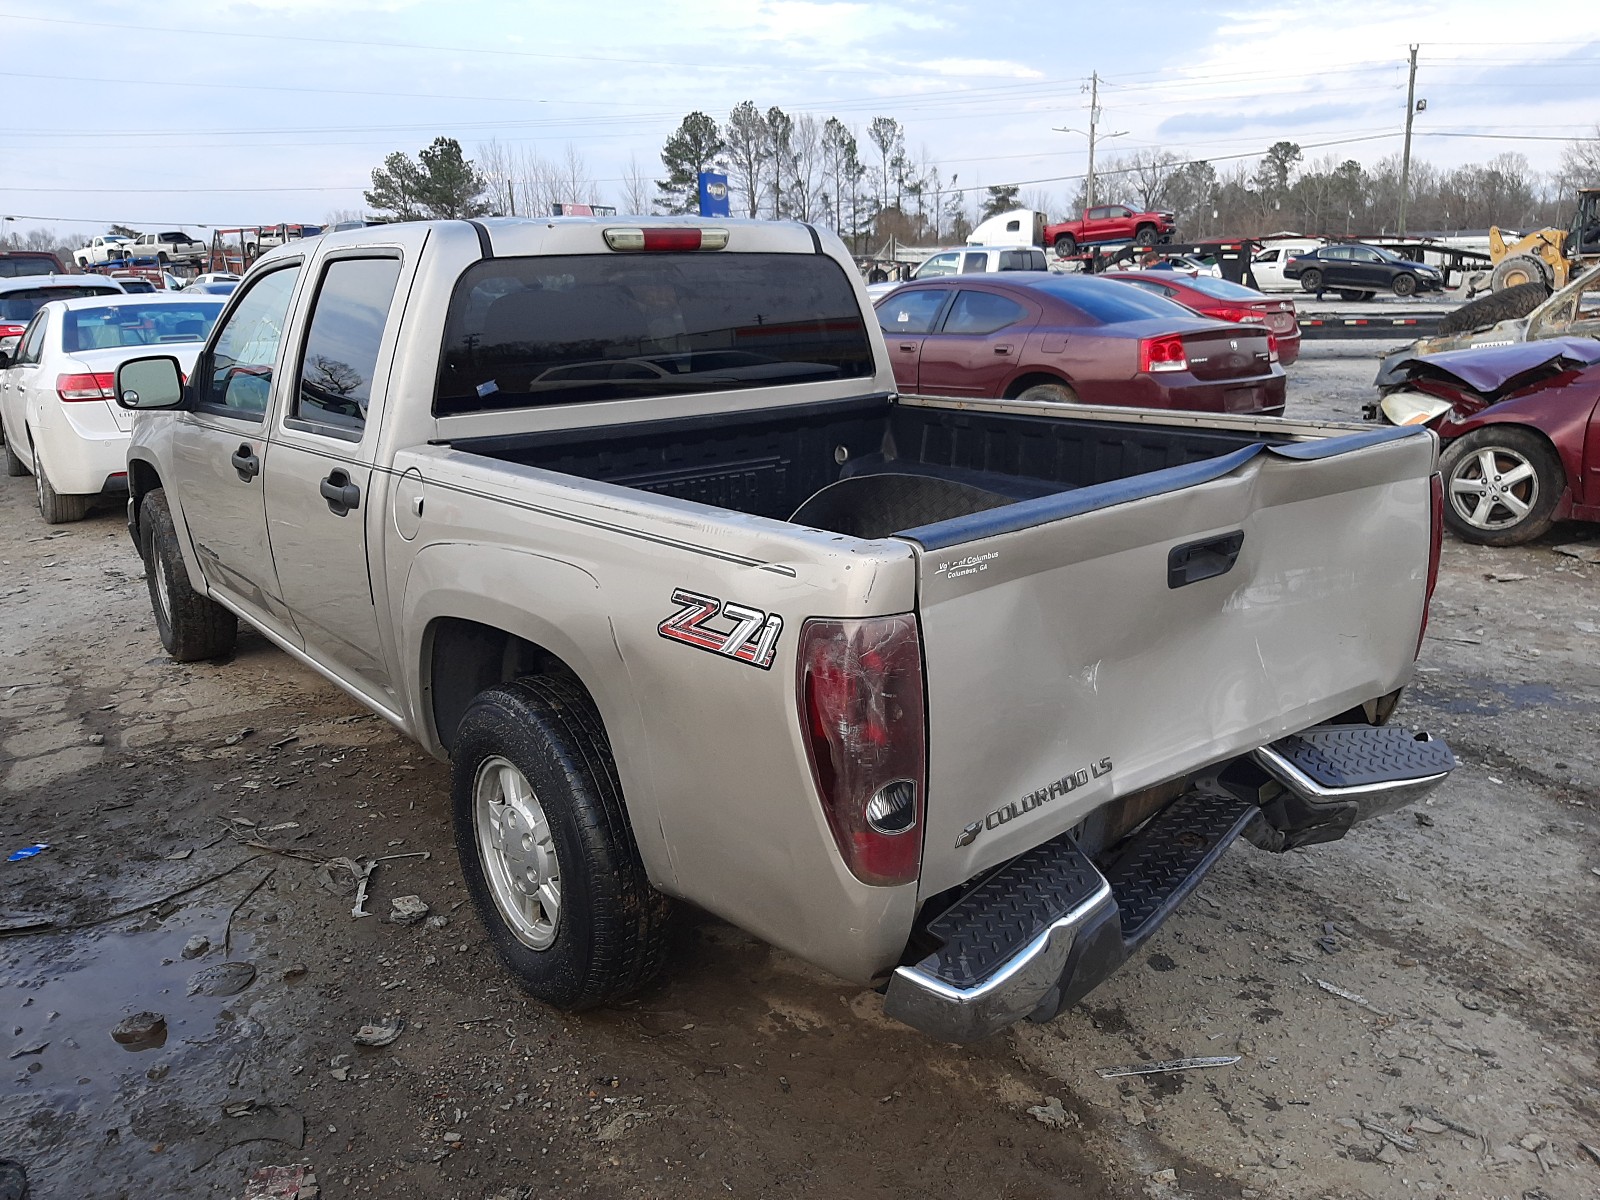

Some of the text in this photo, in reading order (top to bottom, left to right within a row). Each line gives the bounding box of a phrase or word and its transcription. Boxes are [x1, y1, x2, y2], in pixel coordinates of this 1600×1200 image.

[947, 563, 988, 579] Columbus, GA
[967, 551, 999, 565] Columbus
[657, 586, 784, 671] Z71
[985, 756, 1113, 831] COLORADO LS
